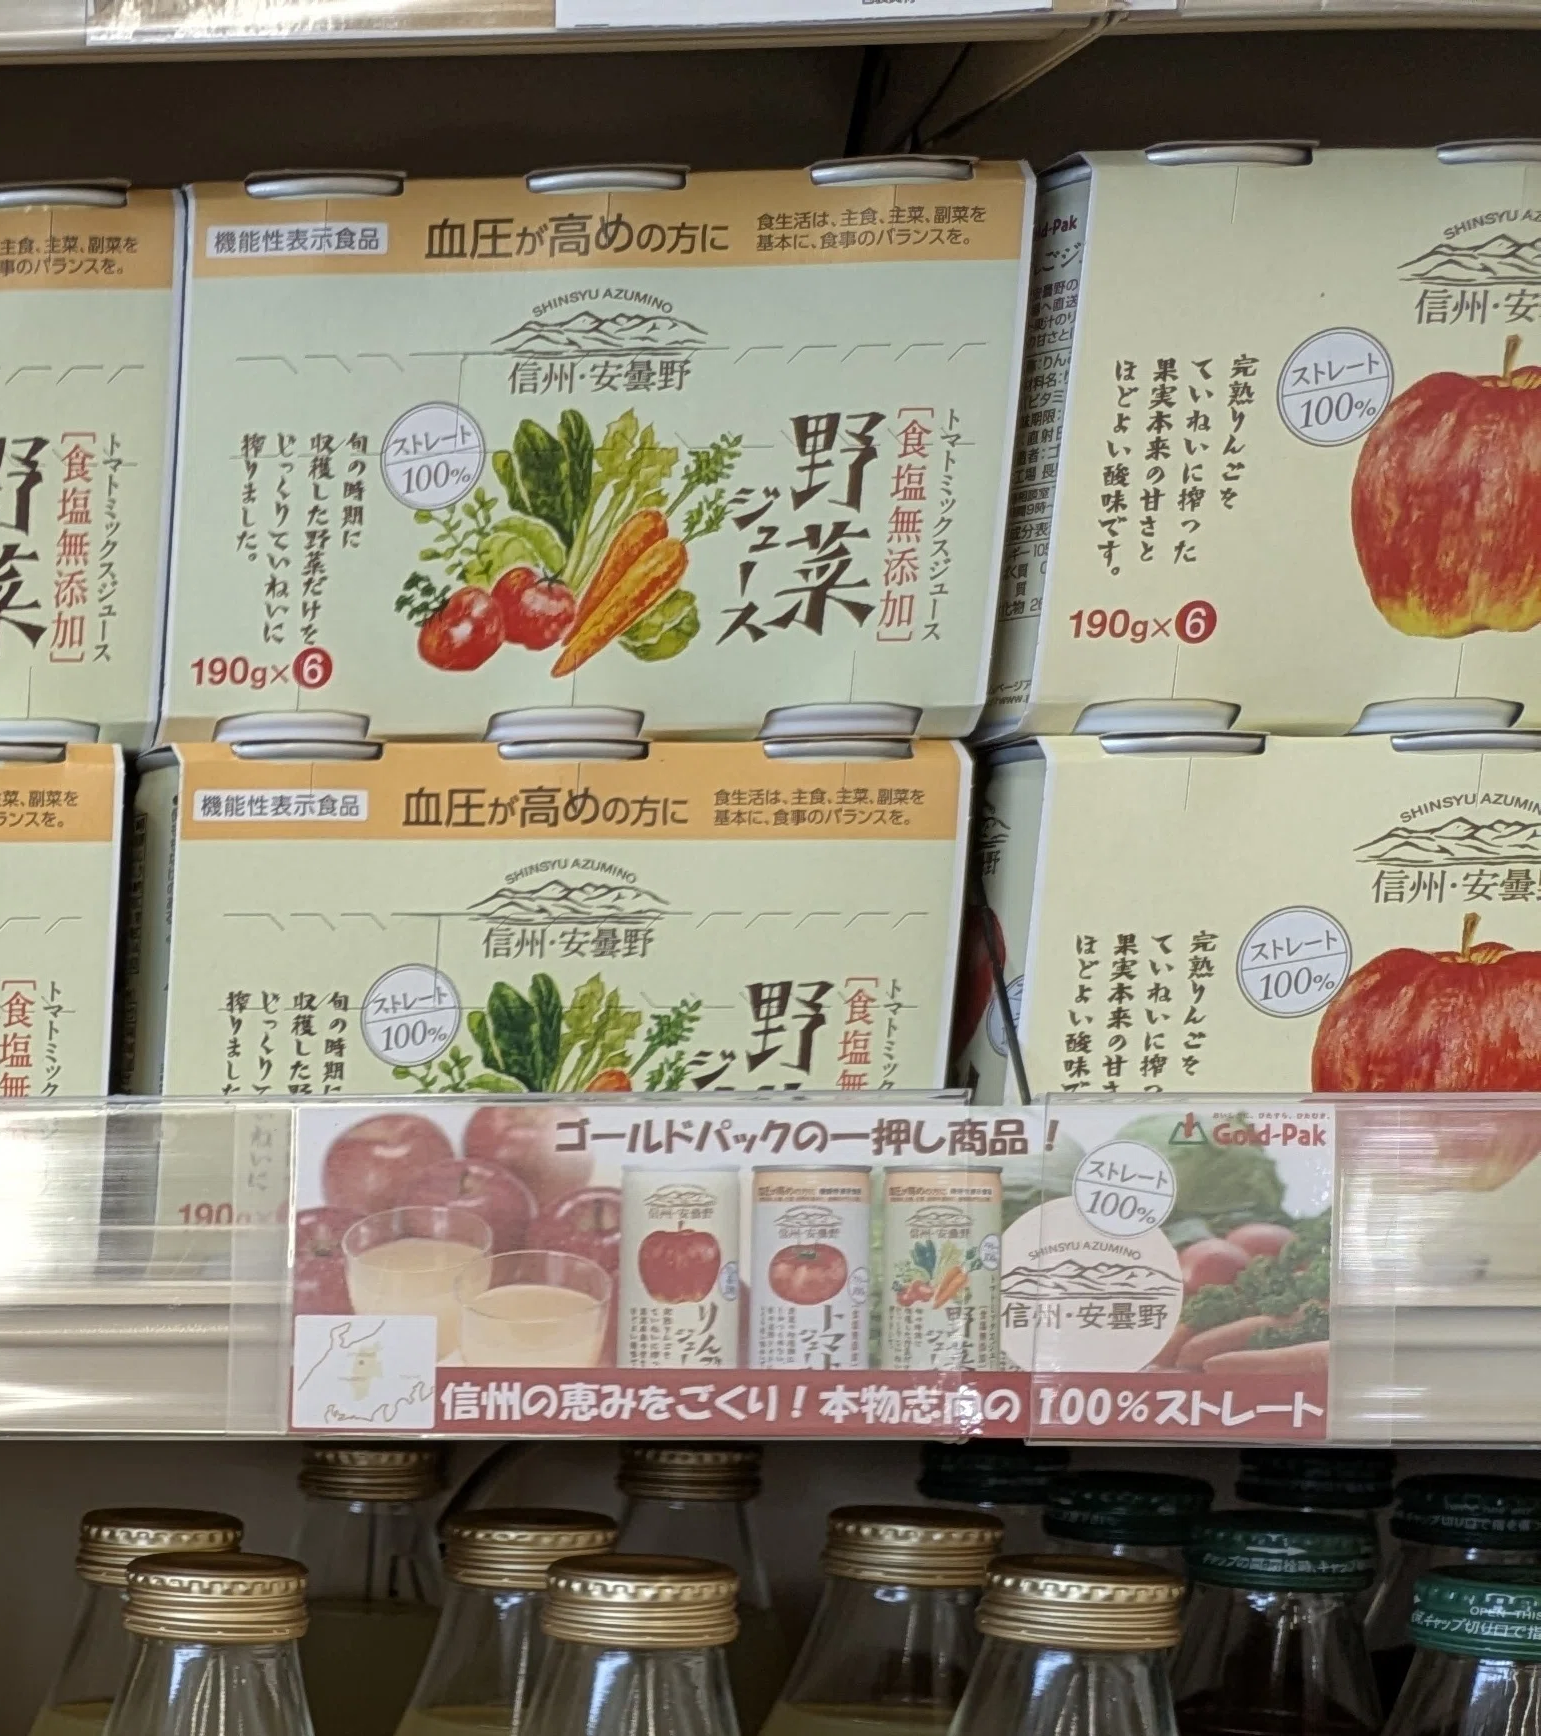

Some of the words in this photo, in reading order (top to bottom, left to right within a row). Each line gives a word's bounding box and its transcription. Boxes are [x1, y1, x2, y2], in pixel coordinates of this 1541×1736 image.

[756, 205, 985, 230] 食生活は、主食、主菜、副菜を
[214, 227, 379, 255] 機能性表示食品
[425, 213, 729, 260] 血圧が高めの方に
[755, 227, 971, 251] 基本に、食事のバランスを。
[532, 289, 599, 317] SHINSYU
[602, 289, 673, 313] AZUMINO
[1291, 352, 1380, 386] ストレート
[1298, 394, 1377, 430] 100%
[391, 424, 471, 457] ストレート
[1219, 354, 1257, 509] 完熟りんごを
[1098, 359, 1138, 579] ほどよい酸味です。
[1139, 357, 1177, 564] 果実本来の甘さと
[1174, 357, 1214, 565] ていねいに搾った
[400, 460, 471, 497] 100%
[777, 412, 886, 637] 野菜
[716, 486, 780, 645] ジュース
[201, 794, 360, 817] 機能性表示食品
[403, 785, 689, 828] 血圧が高めの方に
[1212, 1123, 1326, 1146] Gold-Pak
[1084, 1160, 1167, 1190] ストレート
[1086, 1193, 1156, 1224] 100%
[1028, 1242, 1082, 1262] SHINSYU
[1084, 1241, 1141, 1261] AZUMINO
